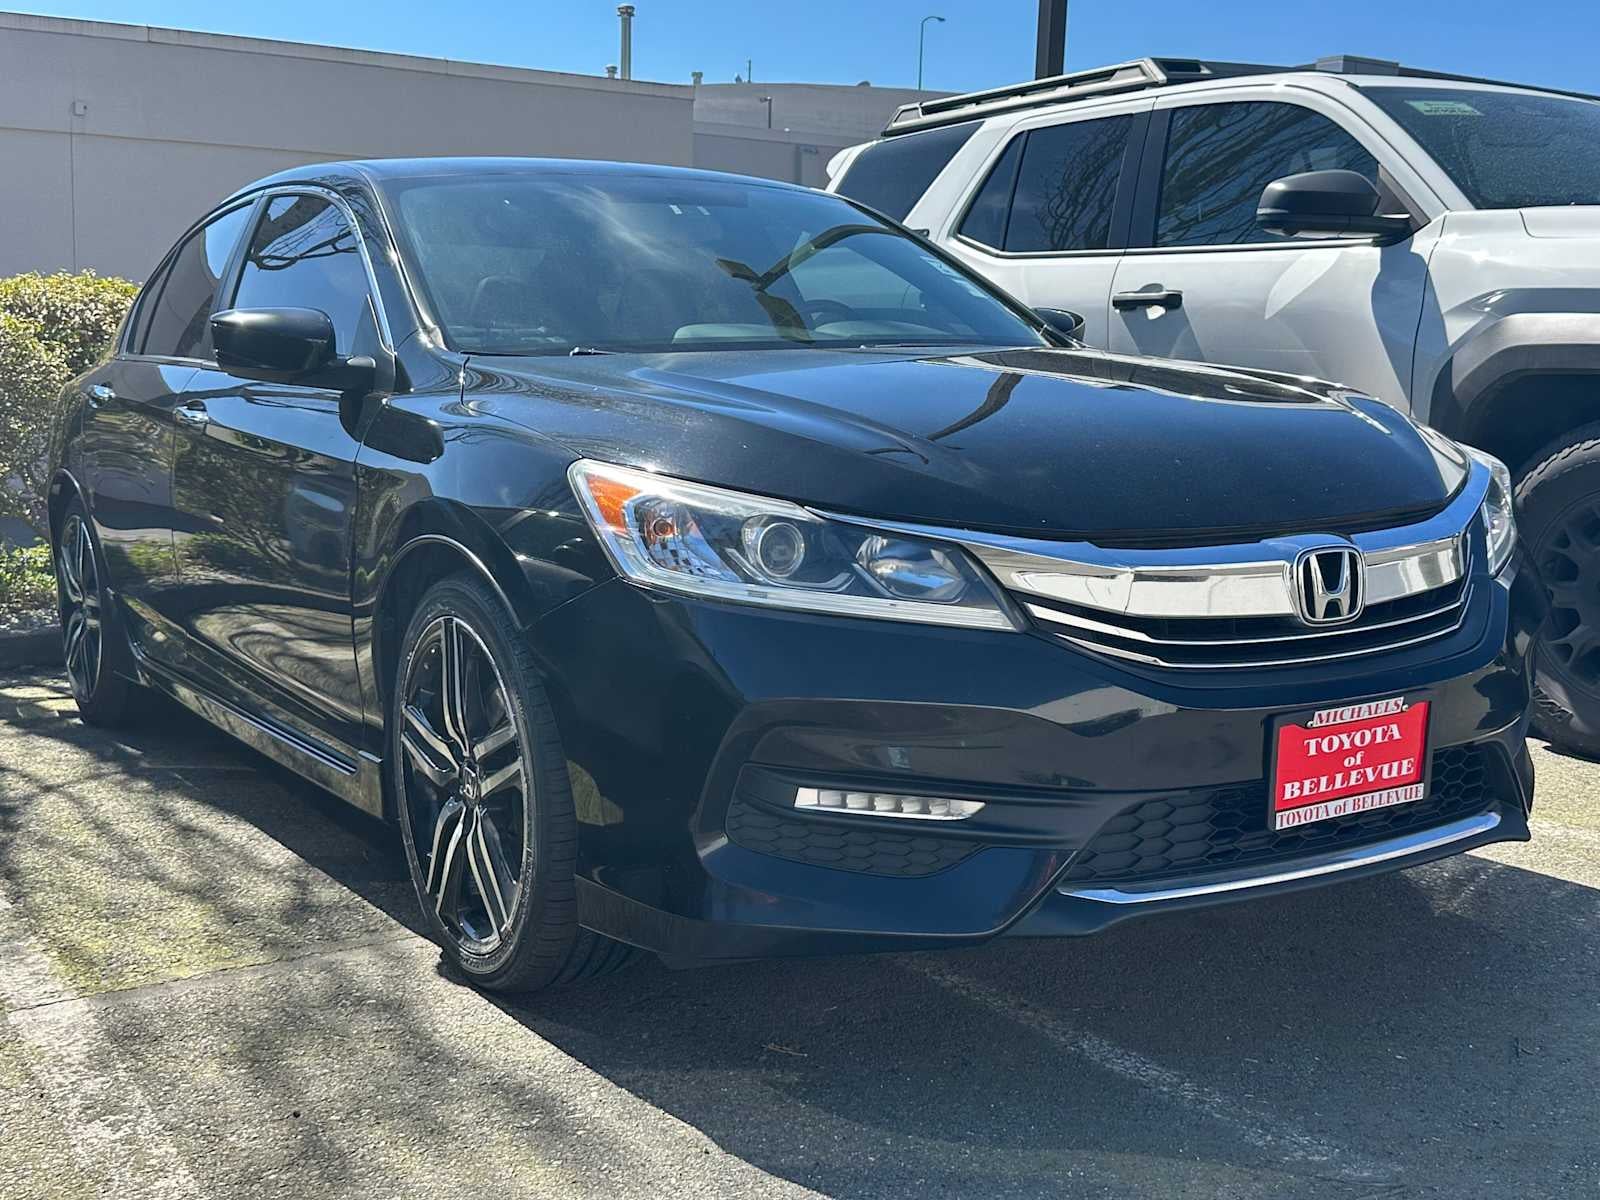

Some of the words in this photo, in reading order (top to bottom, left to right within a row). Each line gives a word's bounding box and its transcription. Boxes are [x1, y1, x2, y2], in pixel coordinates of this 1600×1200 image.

[1315, 699, 1402, 726] MICHAELS
[1304, 723, 1402, 757] TOYOTA
[1343, 751, 1365, 768] of
[1282, 757, 1416, 801] BELLEVUE
[1278, 804, 1330, 828] TOYOTA
[1334, 800, 1348, 815] of
[1352, 785, 1424, 812] BELLEVUE
